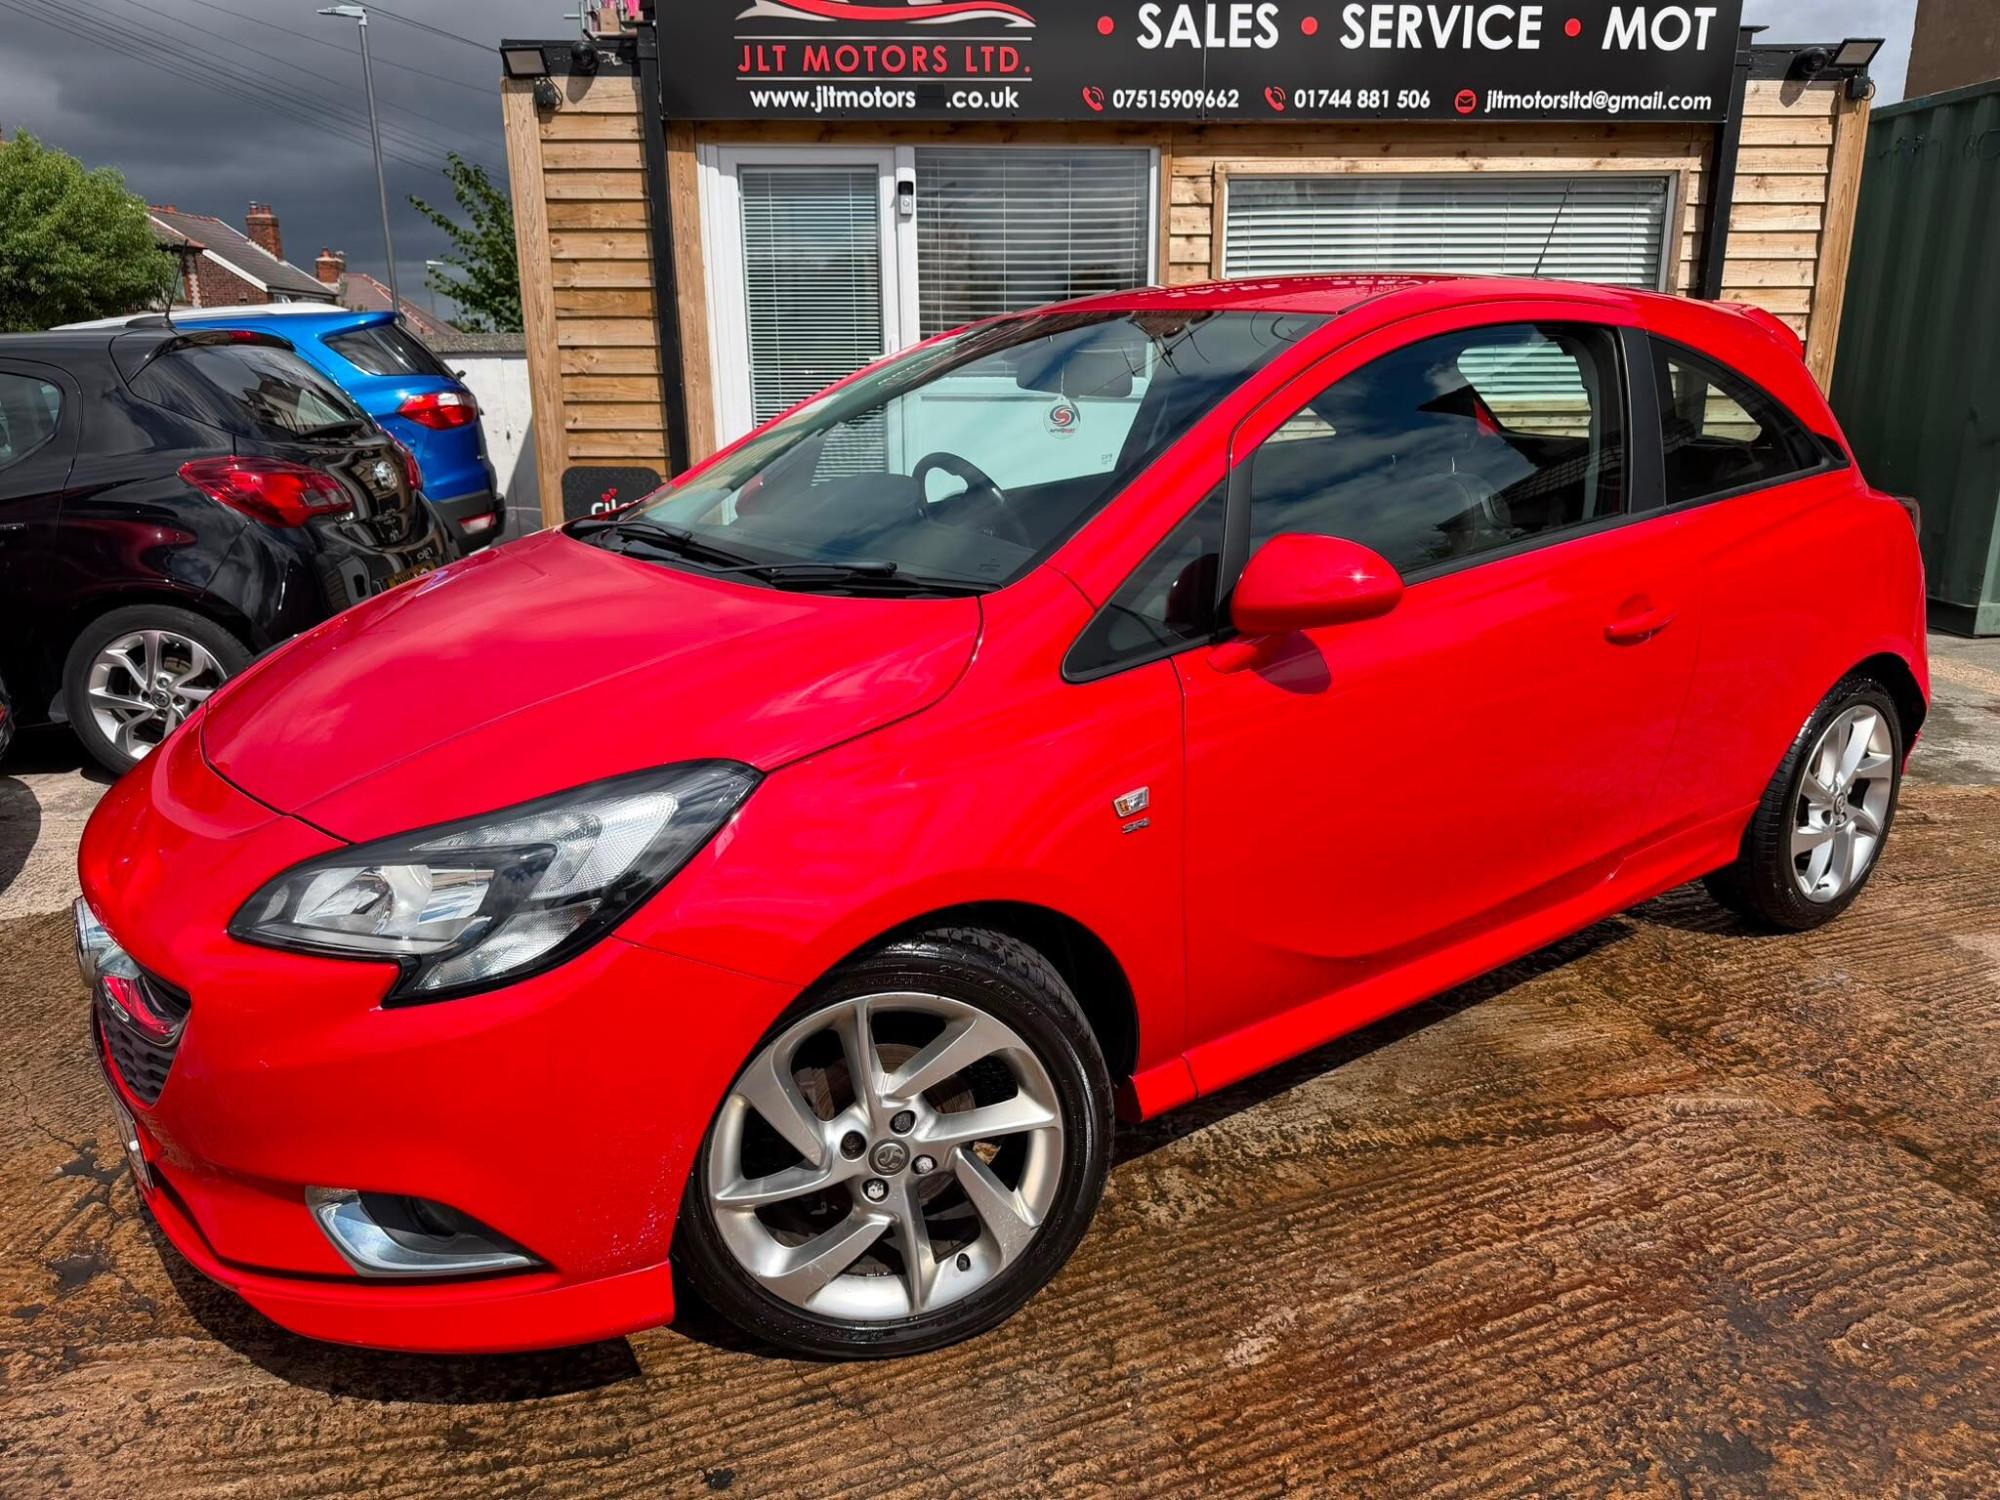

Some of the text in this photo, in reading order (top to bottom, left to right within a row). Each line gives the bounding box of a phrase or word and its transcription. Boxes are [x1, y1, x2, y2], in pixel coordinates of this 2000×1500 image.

[1137, 4, 1717, 51] SALES SERVICE MOT
[738, 45, 1030, 73] JLT MOTORS LTD.
[750, 86, 1019, 112] www.jltmotors .co.uk
[1113, 89, 1239, 108] 07515909662
[1294, 89, 1430, 108] 01744 881 506
[1485, 90, 1711, 113] jltmotorsltd@gmail.com
